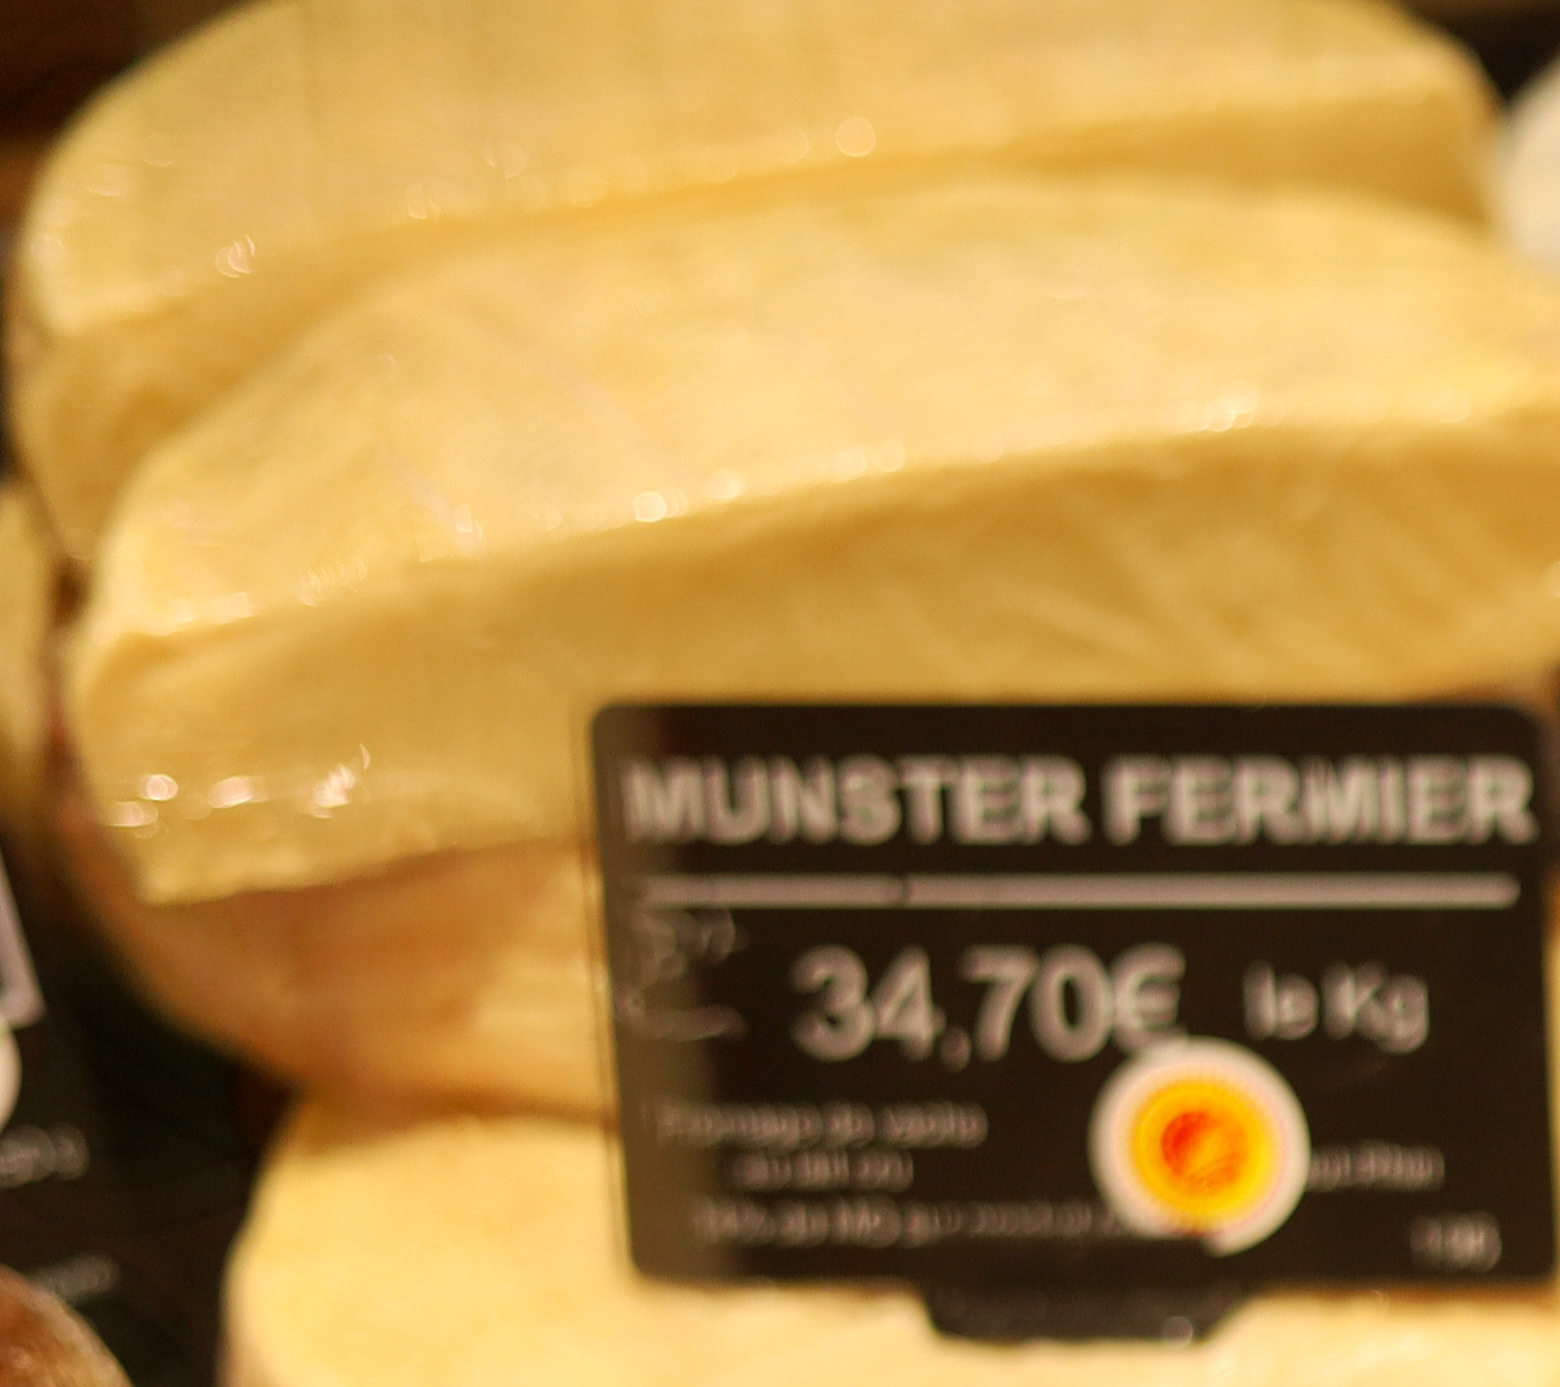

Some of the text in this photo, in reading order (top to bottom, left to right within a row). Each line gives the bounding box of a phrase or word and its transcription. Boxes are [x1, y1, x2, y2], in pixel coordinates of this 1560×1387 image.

[623, 753, 1539, 847] MUNSTER FERMIER
[1244, 962, 1320, 1041] le
[1325, 962, 1431, 1054] Kg
